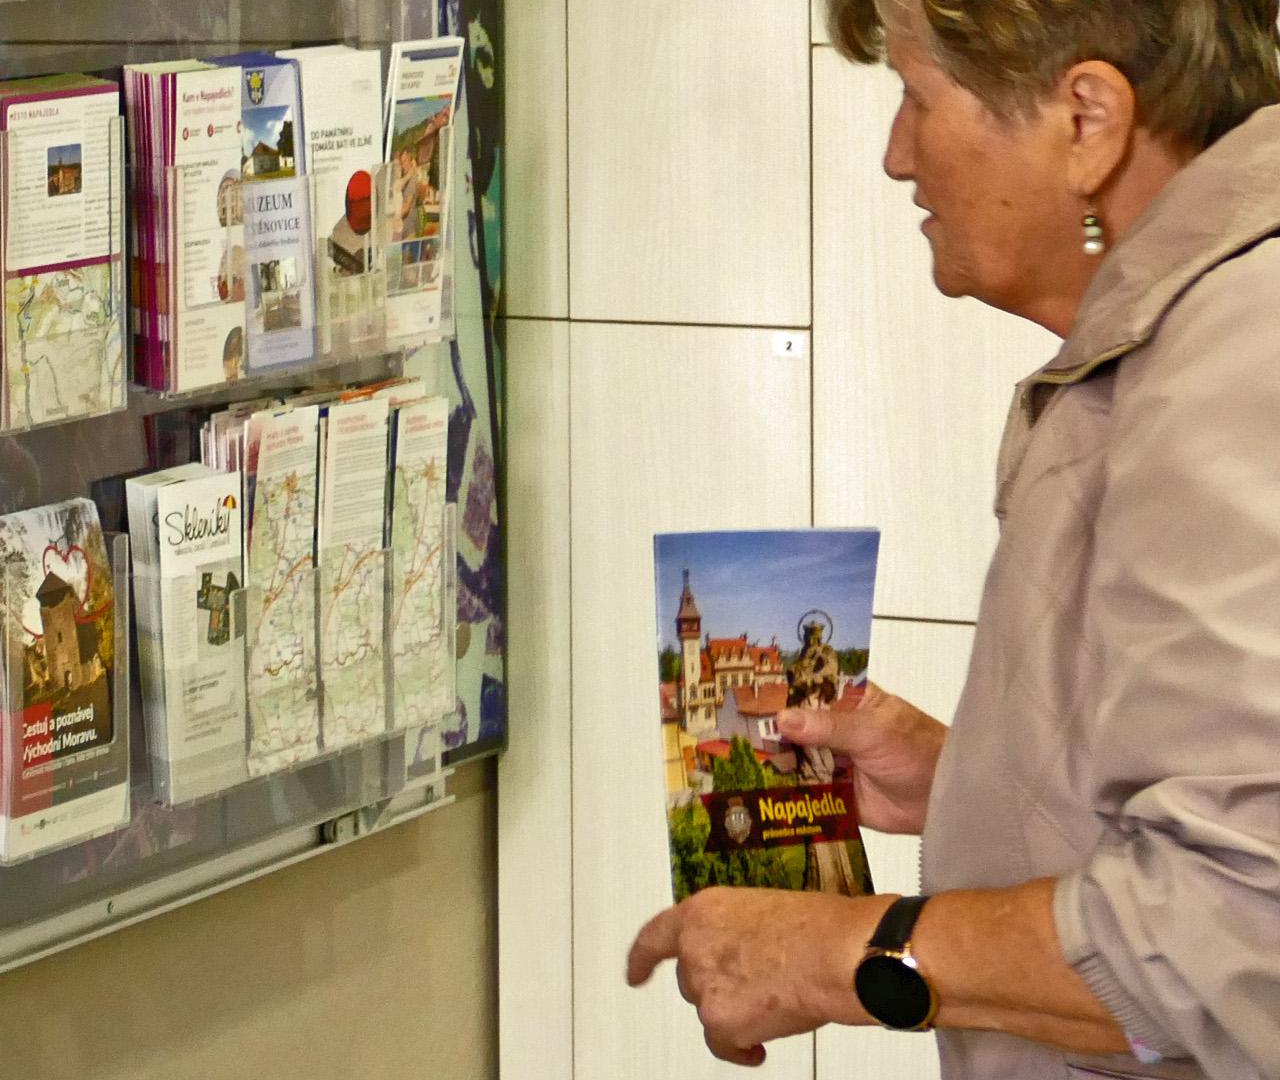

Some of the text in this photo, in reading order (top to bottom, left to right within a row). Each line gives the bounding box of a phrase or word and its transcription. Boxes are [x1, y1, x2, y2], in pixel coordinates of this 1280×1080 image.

[49, 720, 55, 731] a
[56, 702, 94, 732] poznávej
[62, 728, 98, 749] Moravu.
[758, 791, 848, 825] Napajedla
